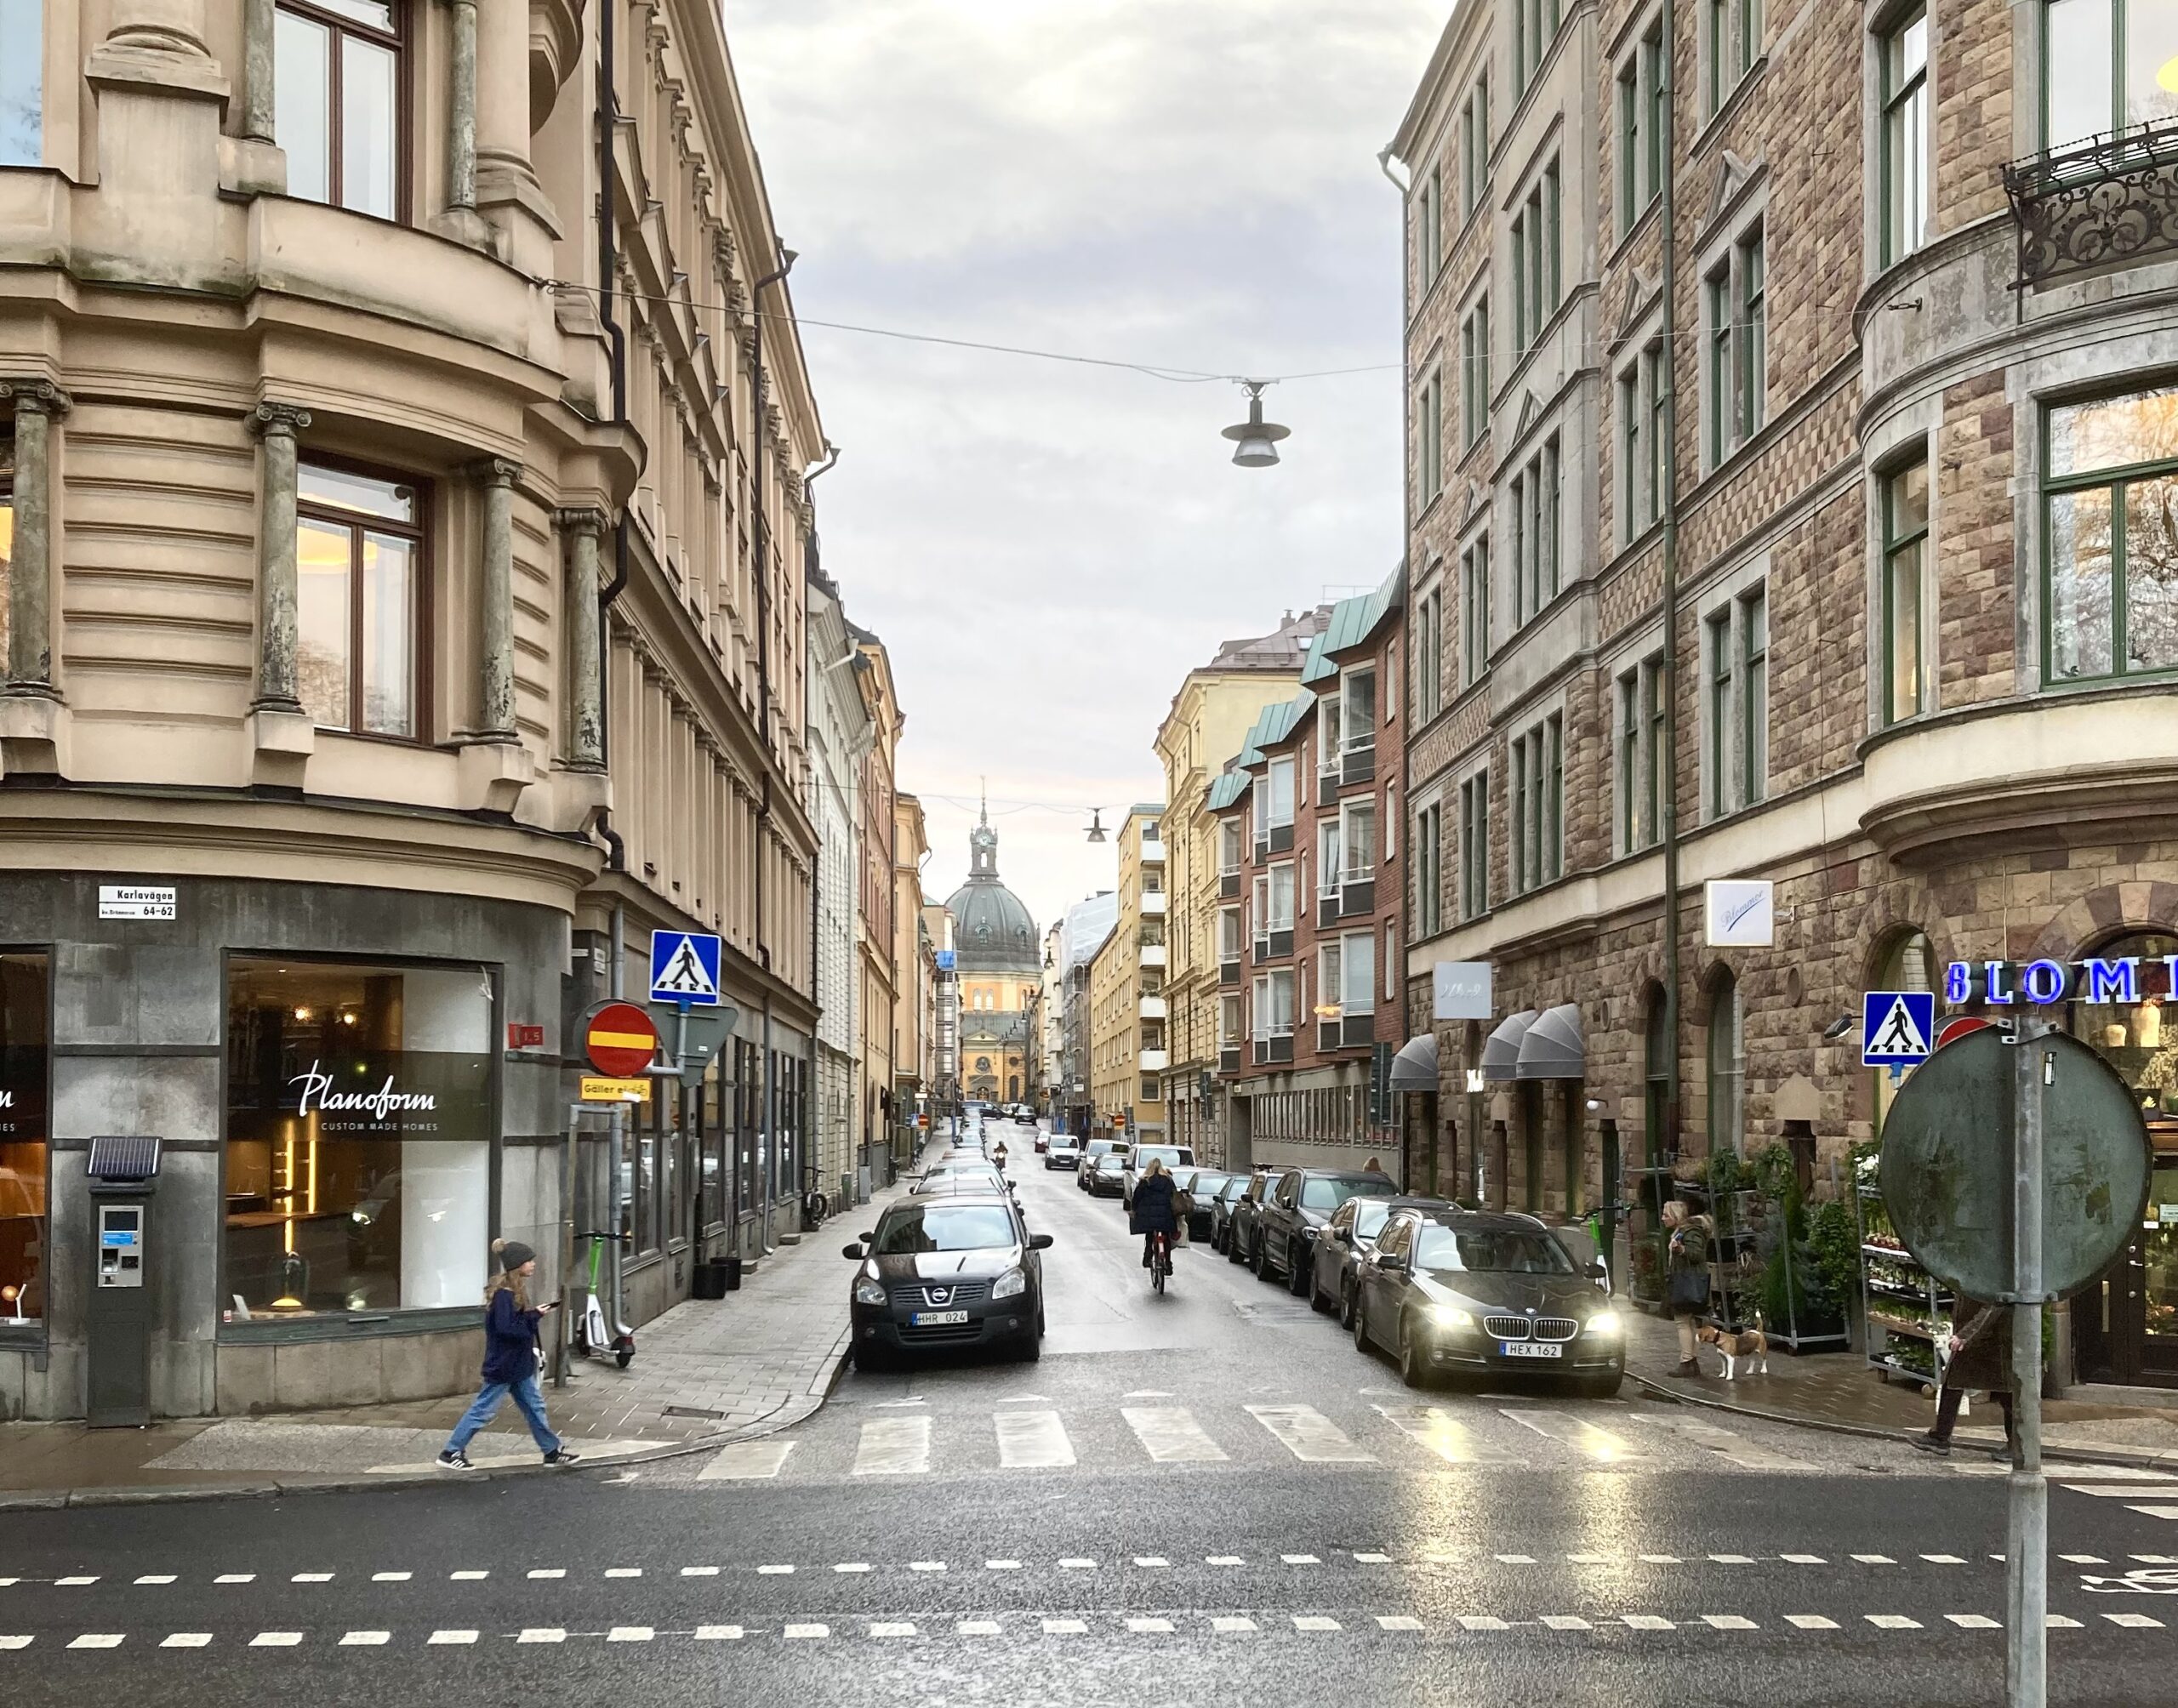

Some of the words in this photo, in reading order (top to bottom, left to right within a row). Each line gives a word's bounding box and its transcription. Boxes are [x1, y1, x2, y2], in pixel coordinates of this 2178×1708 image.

[117, 889, 173, 902] Karlavägen
[143, 906, 173, 916] 64-62
[288, 1059, 437, 1120] Planoform
[584, 1084, 614, 1094] Gäller
[321, 1122, 365, 1130] CUSTOM
[369, 1122, 397, 1130] MADE
[402, 1123, 438, 1131] HOMES
[918, 1313, 938, 1324] HHR
[945, 1312, 966, 1323] 024
[1509, 1344, 1532, 1355] HEX
[1537, 1345, 1558, 1356] 162
